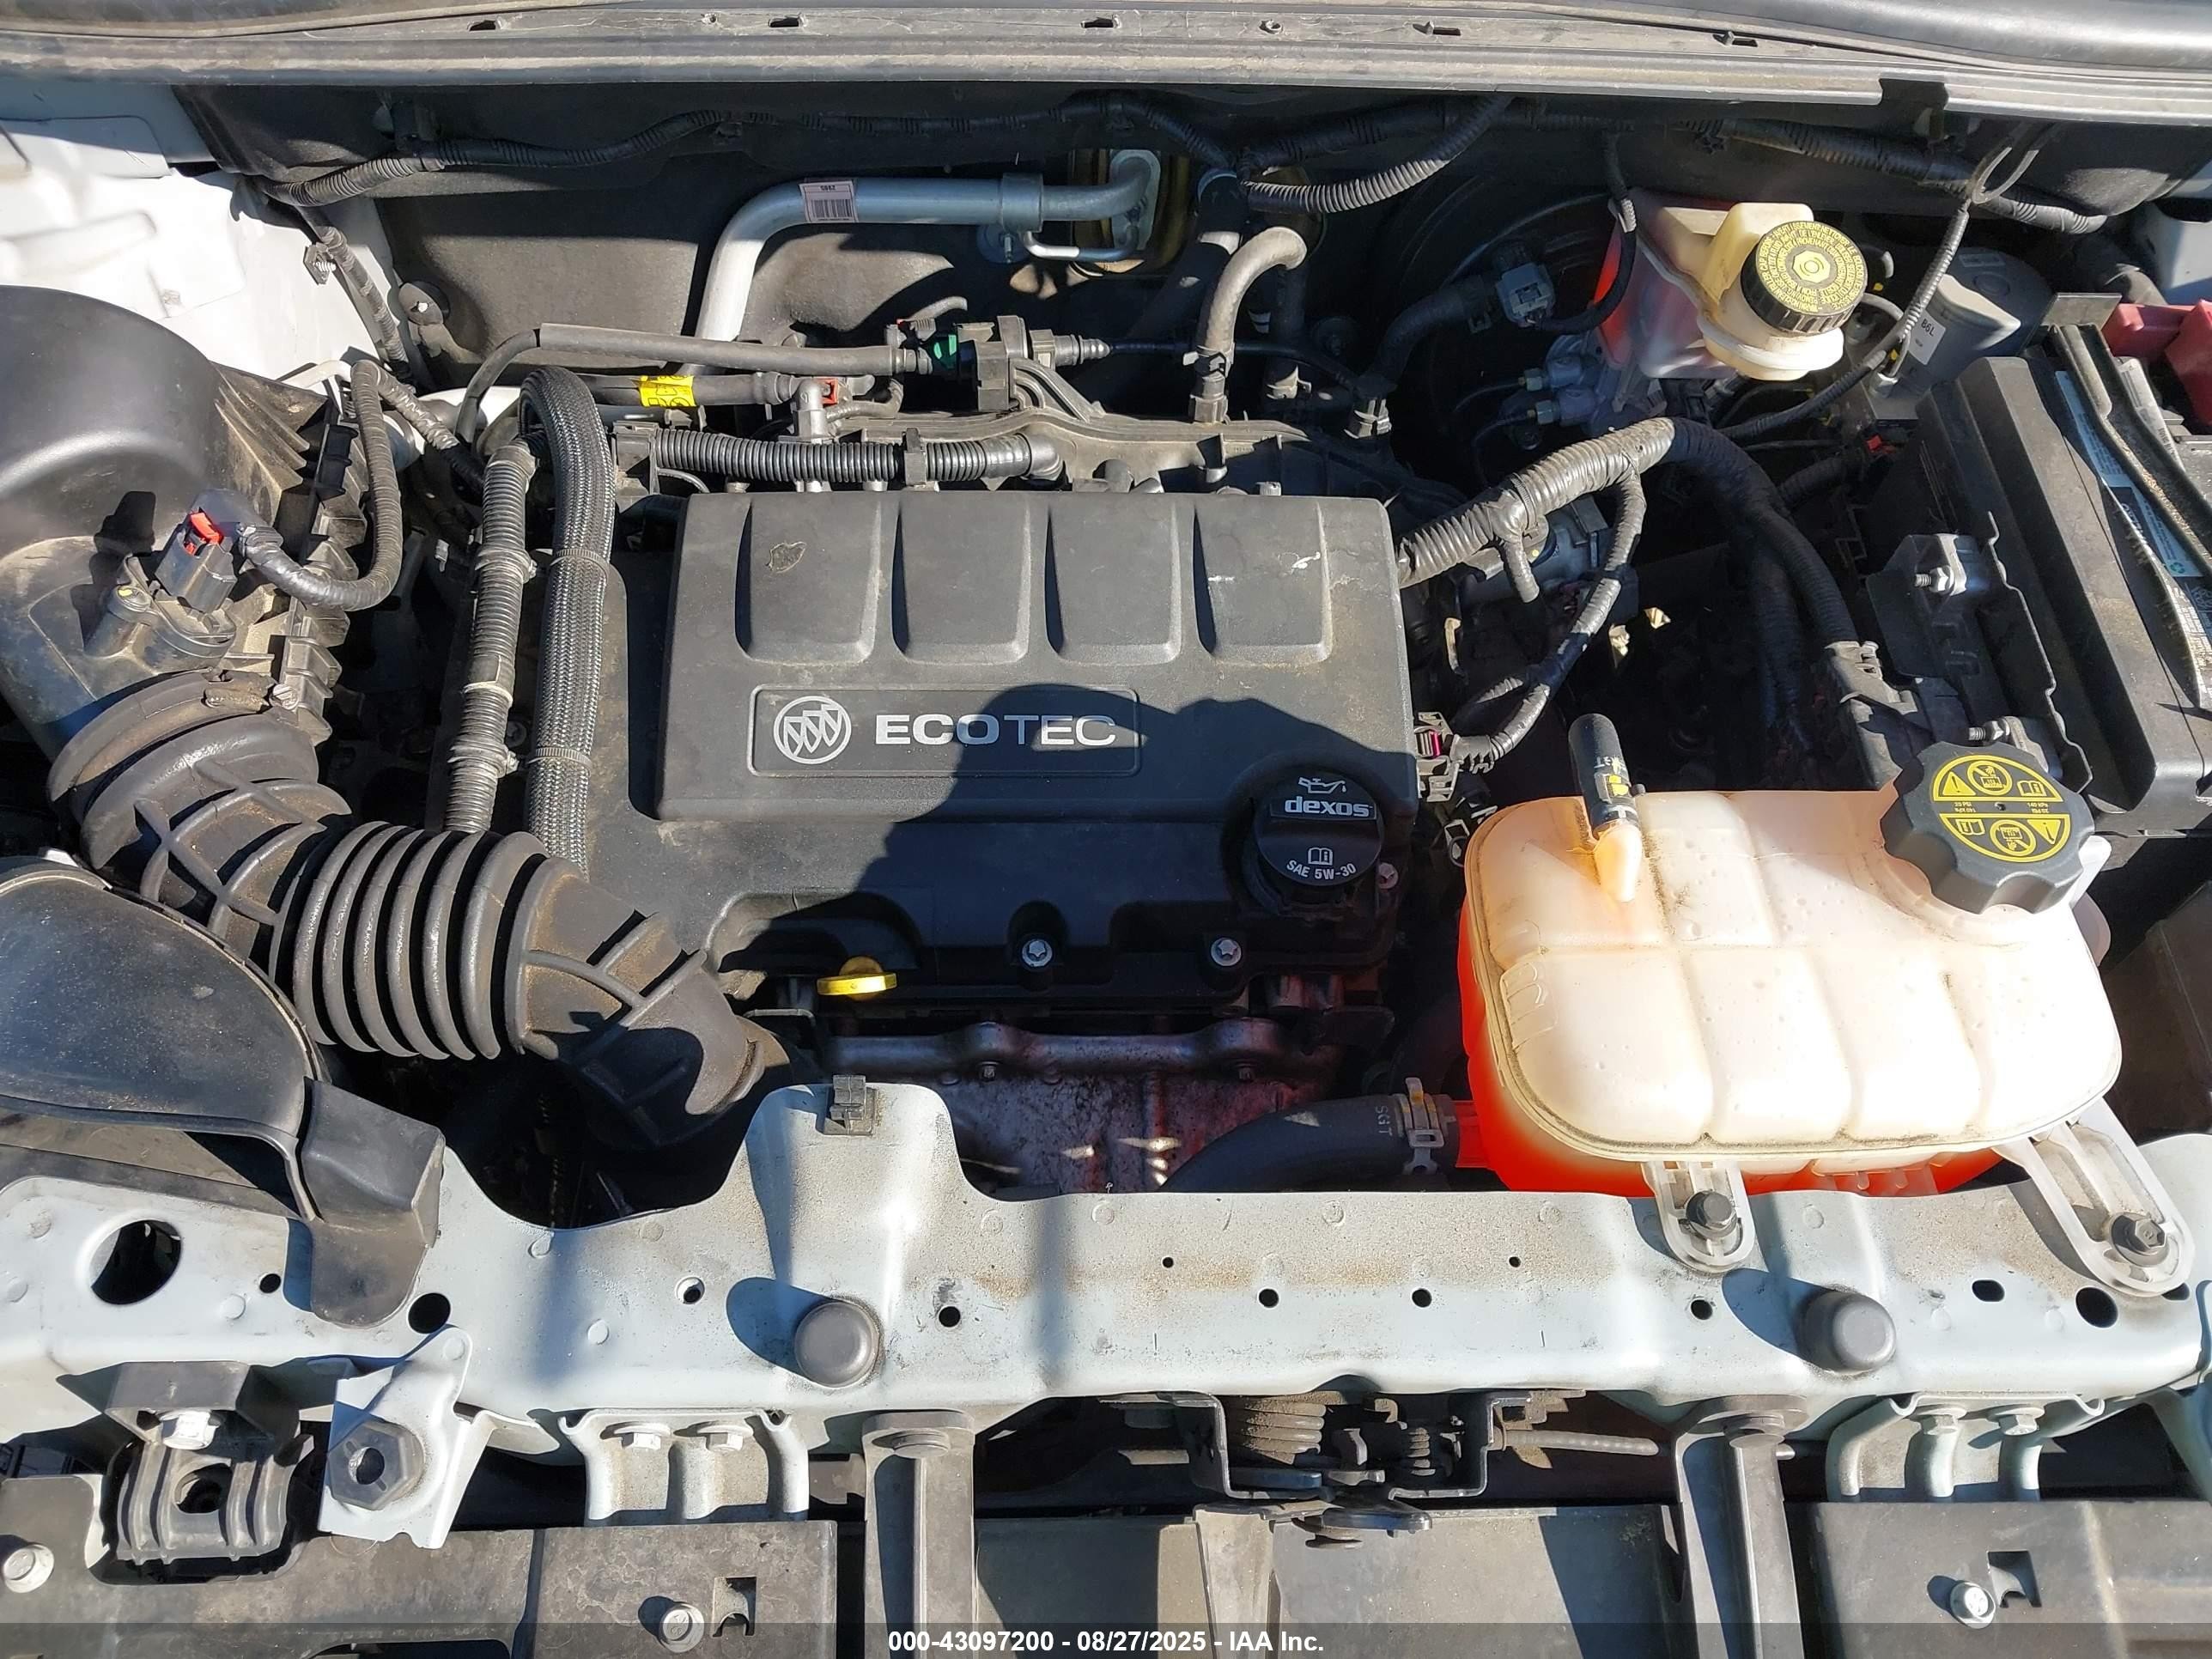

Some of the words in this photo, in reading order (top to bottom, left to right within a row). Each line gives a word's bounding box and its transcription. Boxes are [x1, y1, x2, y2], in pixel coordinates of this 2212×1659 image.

[1846, 244, 1859, 254] LE
[1921, 318, 1936, 337] B6L
[875, 714, 1116, 745] ECOTEC
[1285, 796, 1370, 817] dexos
[1286, 860, 1310, 878] SAE
[1314, 863, 1357, 880] 5W-30
[1376, 1105, 1393, 1136] SGT
